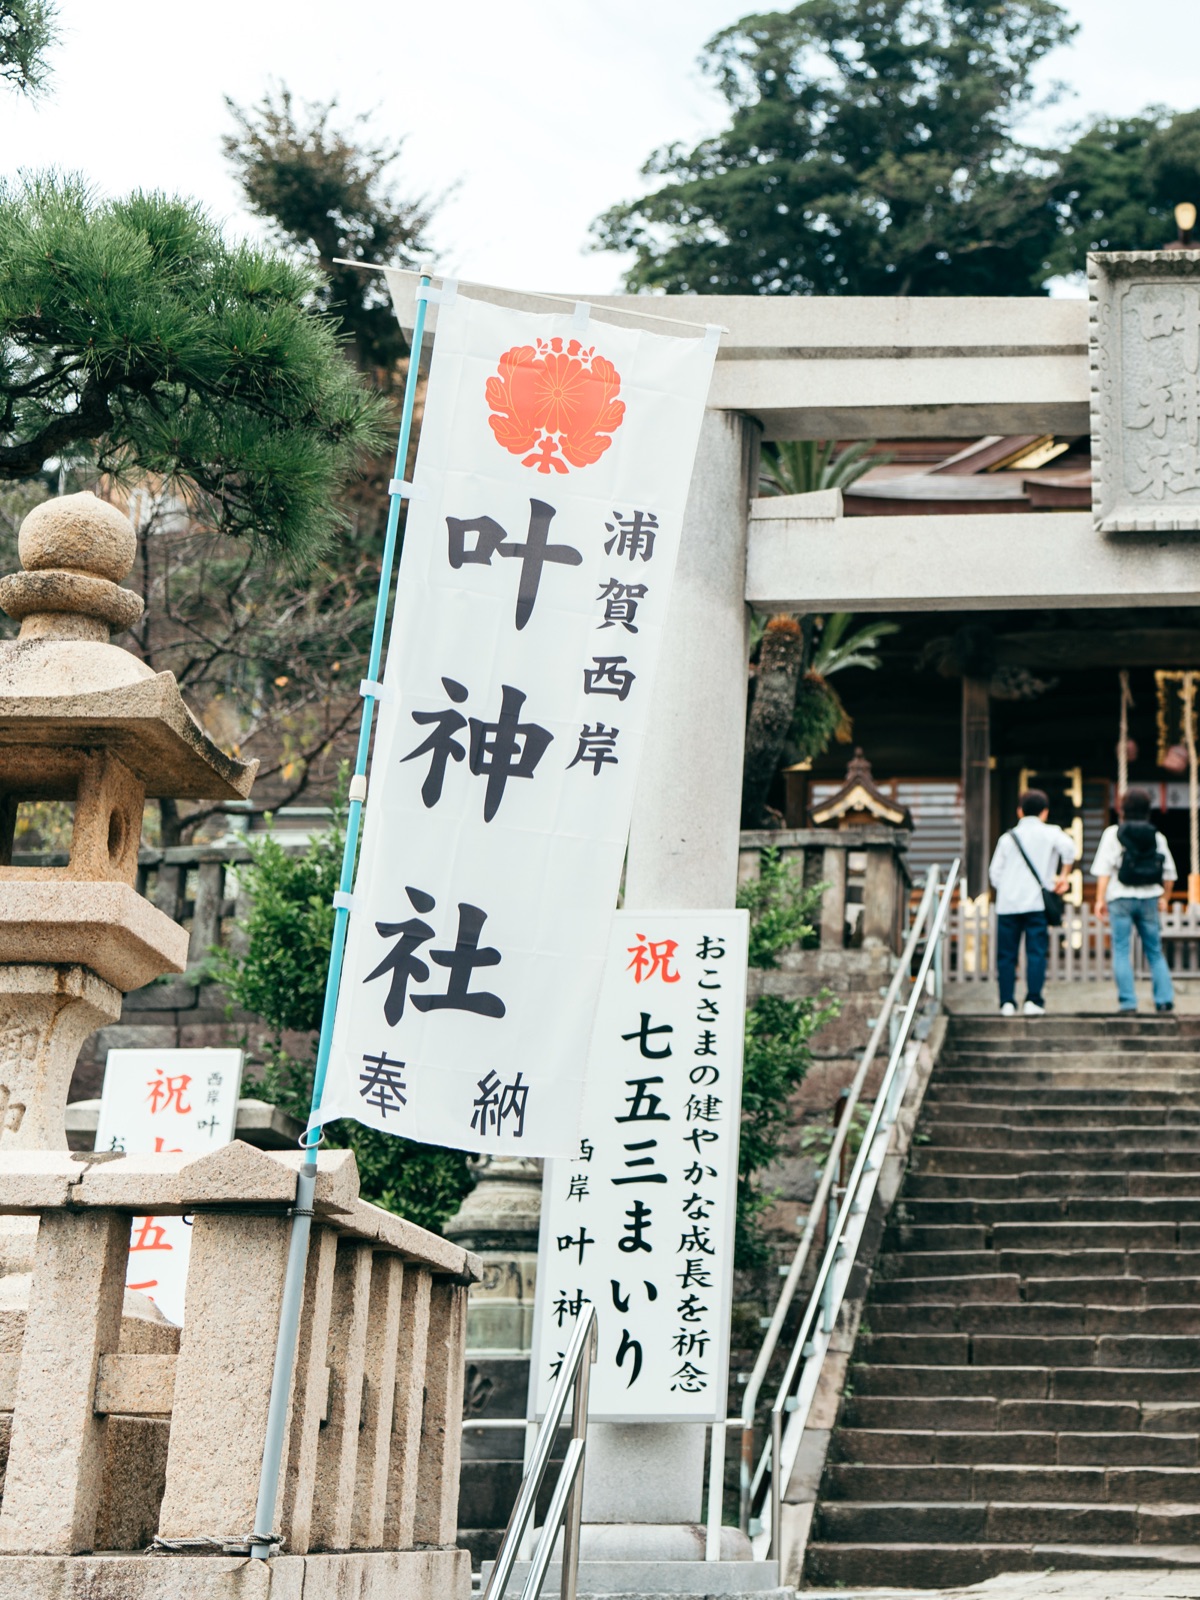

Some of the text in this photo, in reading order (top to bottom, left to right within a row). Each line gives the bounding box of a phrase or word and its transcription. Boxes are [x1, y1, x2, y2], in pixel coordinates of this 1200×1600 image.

[362, 497, 584, 1027] 叶神社
[560, 510, 659, 777] 浦賀西岸
[669, 935, 726, 1392] おこさまの健やかな成長を祈念
